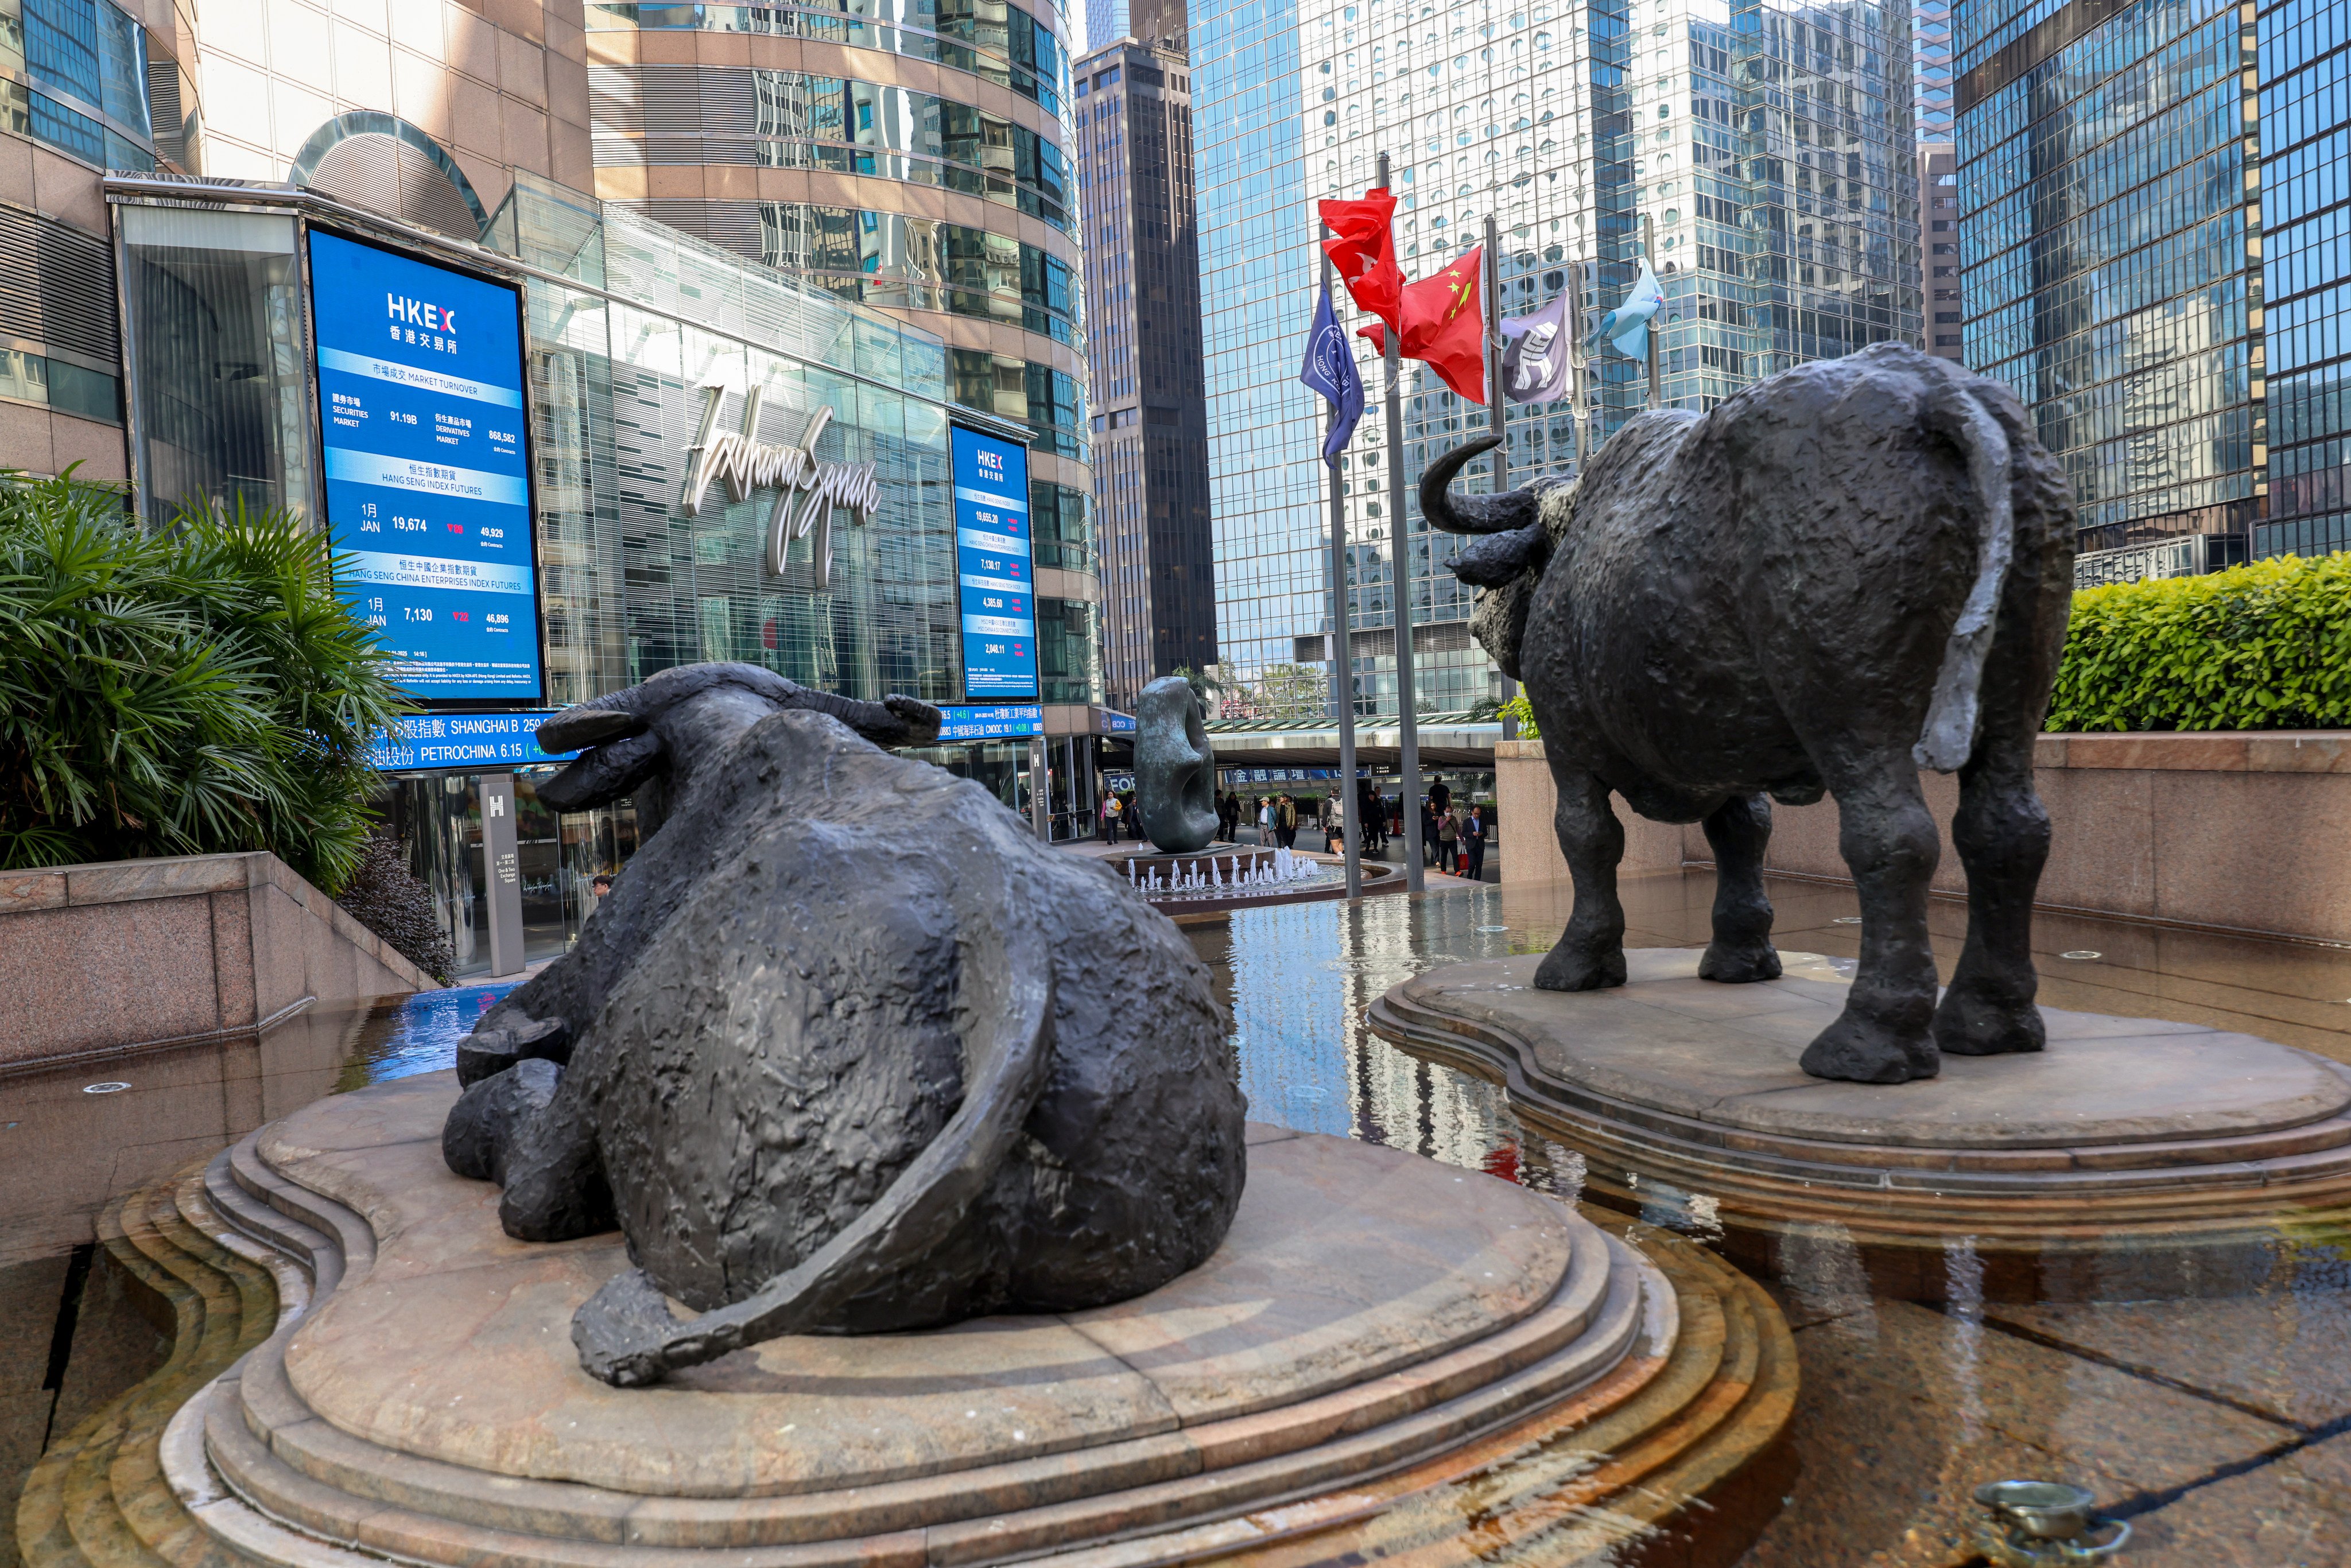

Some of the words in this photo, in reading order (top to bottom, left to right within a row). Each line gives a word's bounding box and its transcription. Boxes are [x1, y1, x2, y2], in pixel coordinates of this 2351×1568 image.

[387, 293, 456, 335] HKEX
[390, 325, 457, 354] 香港交易所
[1317, 355, 1330, 376] HONG
[373, 363, 406, 381] 市場成交
[409, 373, 437, 386] MARKET
[439, 379, 478, 395] TURNOVER
[332, 405, 368, 418] SECURITIES
[390, 411, 417, 425] 91.19B
[333, 416, 359, 428] MARKET
[435, 413, 472, 429] 衍生產品市場
[436, 425, 470, 437] DERIVATIVES
[488, 430, 515, 444] 868,582
[436, 435, 459, 445] MARKET
[977, 449, 1003, 471] HKEX
[979, 468, 1003, 483] 香港交易所
[382, 473, 405, 484] HANG
[406, 477, 426, 487] SENG
[427, 480, 449, 491] INDEX
[451, 484, 482, 495] FUTURES
[362, 503, 377, 518] 1月
[976, 510, 998, 524] 19,655.20
[360, 520, 381, 533] JAN
[392, 515, 427, 533] 19,674
[480, 526, 503, 538] 49,929
[994, 544, 1011, 552] ENTERPRISES
[980, 558, 1000, 570] 7,130.17
[348, 569, 372, 579] HANG
[374, 570, 394, 580] SENG
[396, 573, 420, 583] CHINA
[421, 575, 468, 586] ENTERPRISES
[469, 579, 490, 588] INDEX
[491, 580, 521, 591] FUTURES
[368, 597, 383, 612] 1月
[983, 597, 1003, 608] 4,385.60
[404, 607, 432, 623] 7,130
[459, 612, 469, 622] 22
[486, 614, 509, 624] 46,896
[985, 643, 1004, 655] 2,048.11
[995, 708, 1038, 720] 杜瓊斯工業平均指數
[451, 719, 509, 735] SHANGHAI
[511, 719, 518, 732] B
[952, 724, 984, 738] 中國海洋石油
[986, 724, 1002, 734] CNOOC
[1004, 724, 1012, 733] 19.1
[421, 744, 496, 761] PETROCHINA
[501, 743, 522, 758] 6.15
